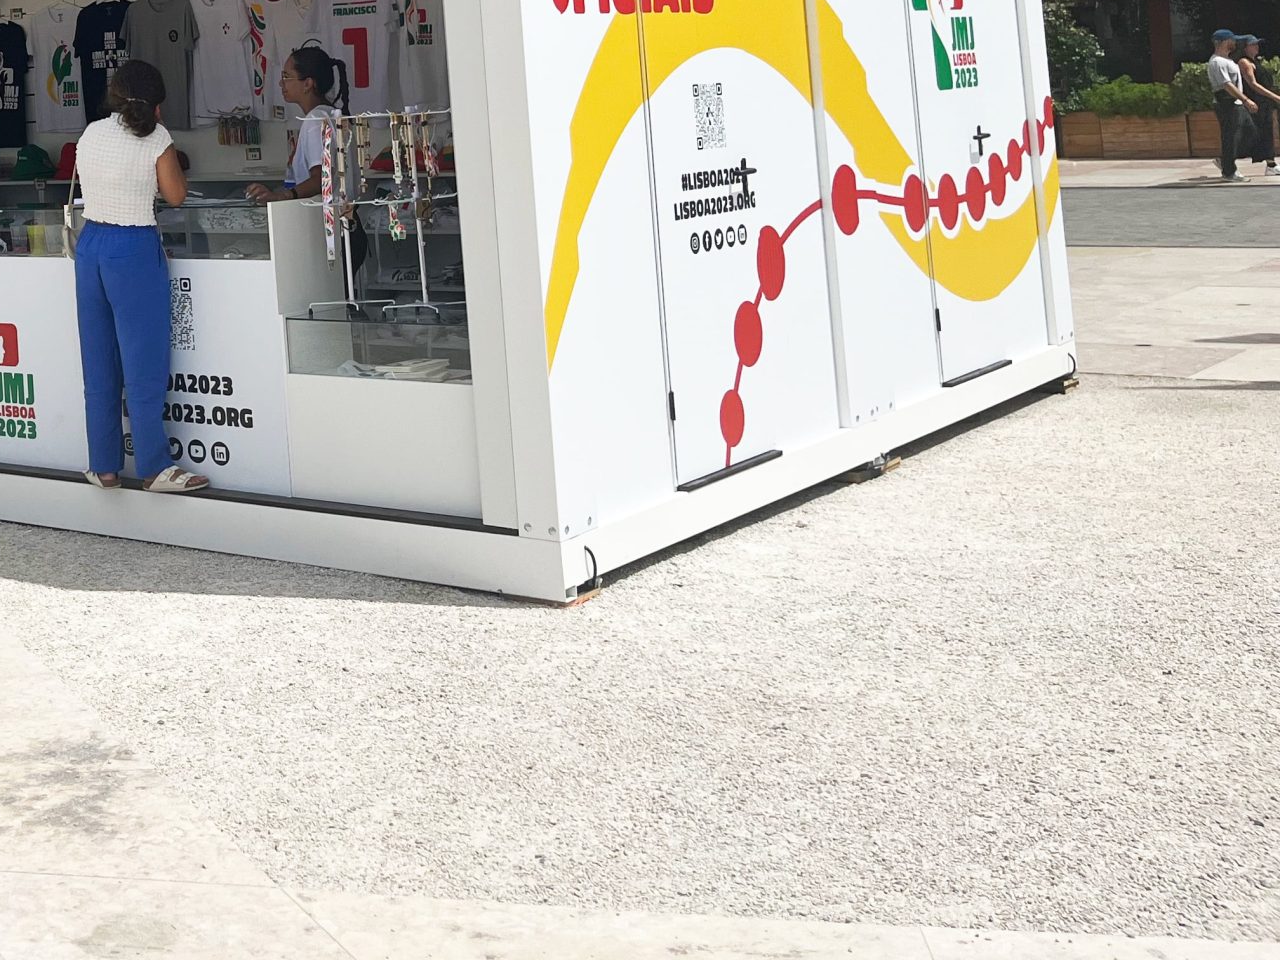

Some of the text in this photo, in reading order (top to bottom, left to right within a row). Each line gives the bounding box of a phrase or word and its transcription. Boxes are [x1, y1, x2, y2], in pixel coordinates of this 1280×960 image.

[333, 5, 377, 17] FRANCISCO
[950, 16, 975, 51] JMJ
[342, 27, 370, 89] 1
[953, 52, 977, 67] LISBOA
[63, 81, 78, 93] JMJ
[954, 67, 978, 89] 2023
[4, 86, 19, 98] JMJ
[63, 99, 79, 107] 2023
[681, 167, 742, 192] #LISBOA202
[674, 191, 756, 221] LISBOA2023.ORG
